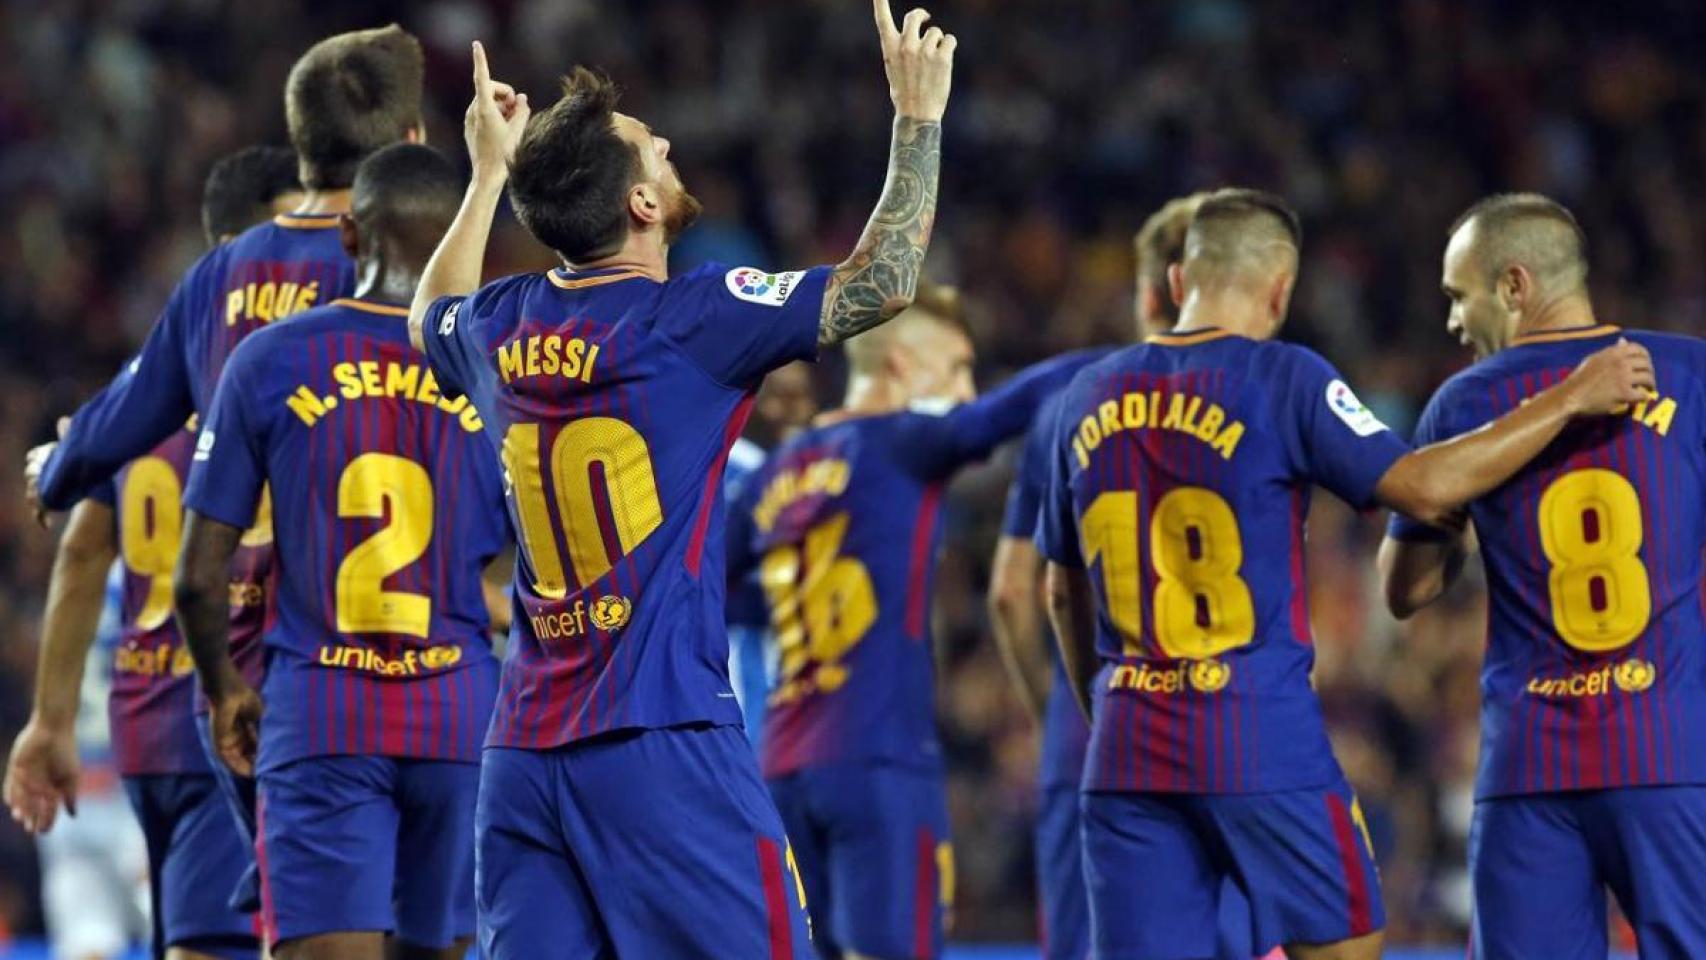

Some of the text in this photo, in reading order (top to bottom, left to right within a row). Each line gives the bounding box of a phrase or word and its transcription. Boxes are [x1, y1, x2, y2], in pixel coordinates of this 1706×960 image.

[227, 281, 318, 326] PIQUÉ
[775, 270, 796, 301] LaLig
[498, 335, 599, 384] MESSI
[287, 385, 338, 427] N.
[1072, 391, 1245, 469] JORDI ALBA
[500, 416, 664, 599] 10
[122, 456, 182, 631] 9
[336, 452, 435, 637] 2
[1539, 468, 1651, 651] 8
[1081, 486, 1255, 658] 18
[532, 601, 584, 639] nicef
[115, 640, 170, 675] nicef
[320, 645, 417, 675] unicef
[1108, 660, 1188, 693] nicef
